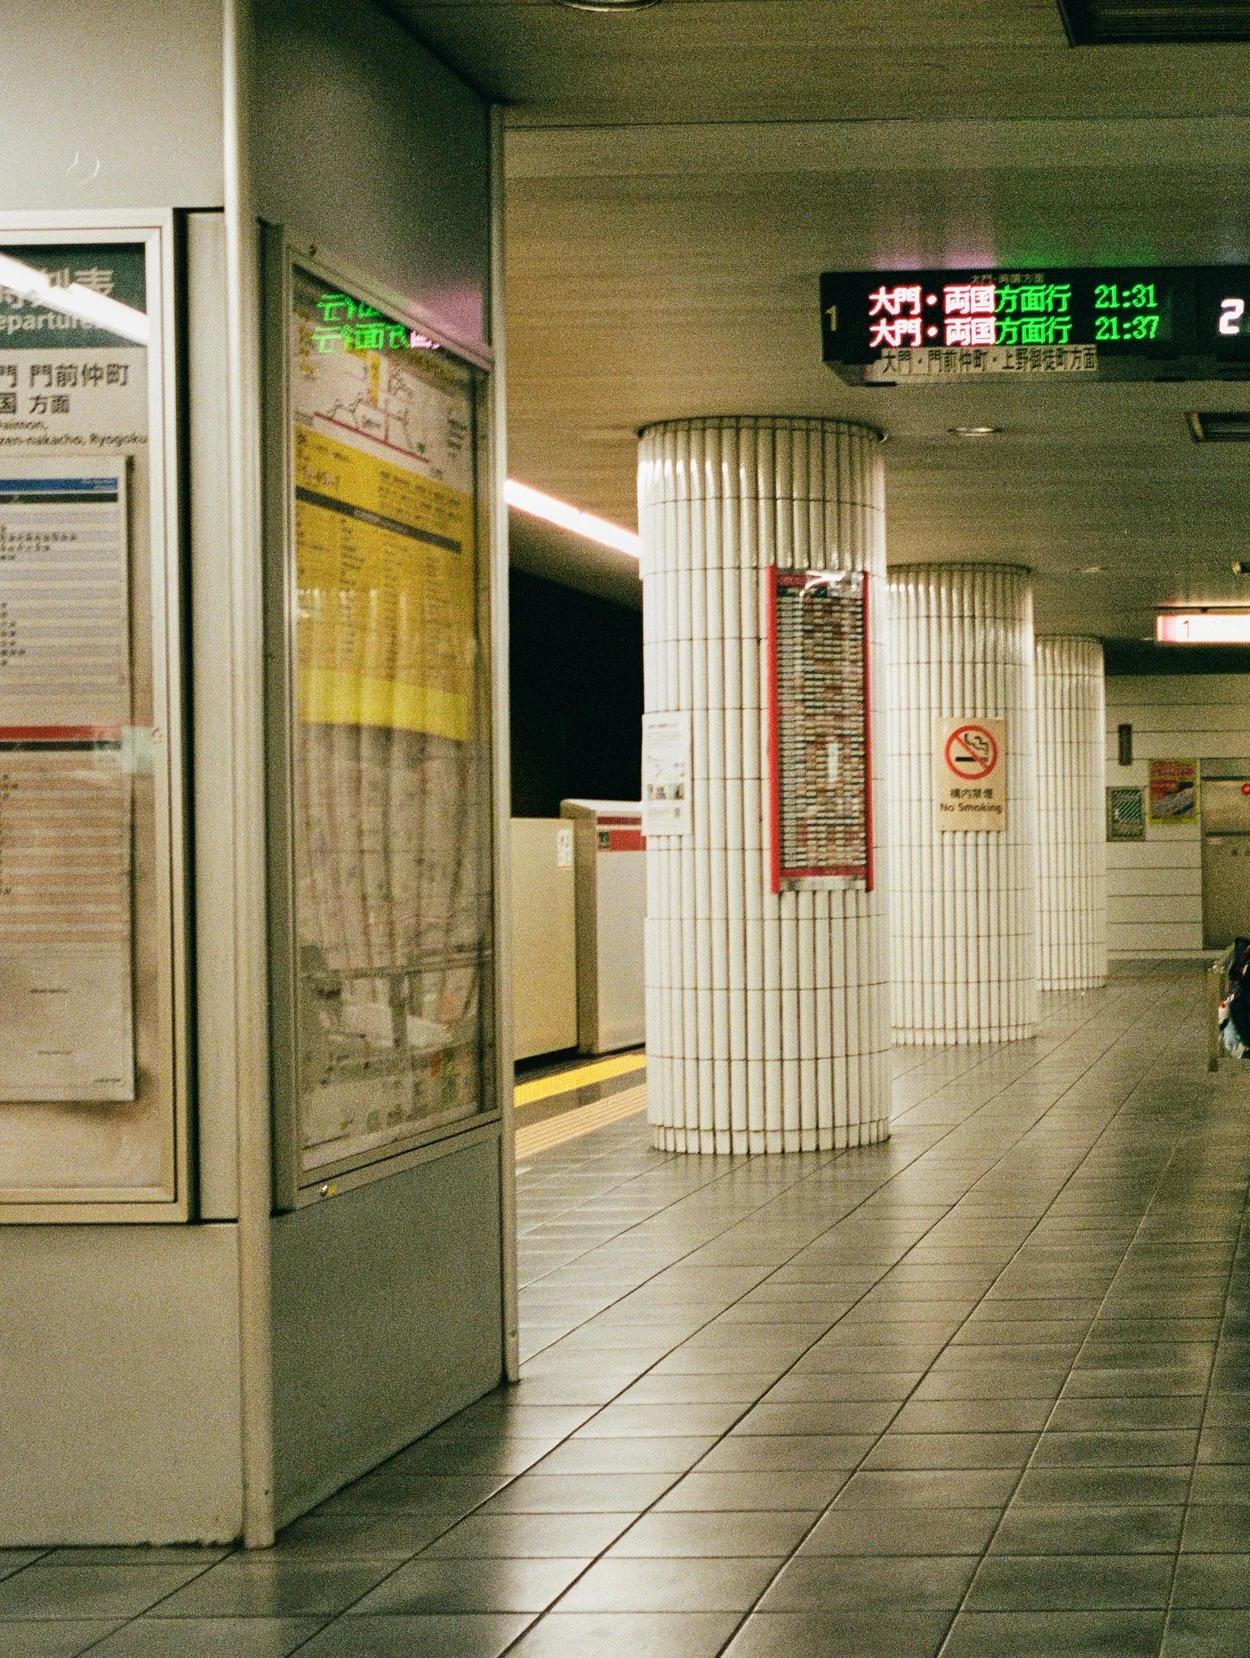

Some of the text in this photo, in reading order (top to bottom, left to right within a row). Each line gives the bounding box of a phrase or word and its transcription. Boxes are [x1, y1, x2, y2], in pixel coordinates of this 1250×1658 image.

[868, 283, 1159, 316] 大門・両国方面行 21:31
[825, 304, 838, 332] 1
[869, 315, 1160, 348] 大門・両国方面行 21:37
[29, 362, 129, 388] 門前仲町
[28, 394, 70, 415] 方面
[1182, 619, 1191, 638] 1
[940, 802, 1003, 815] No Smoking
